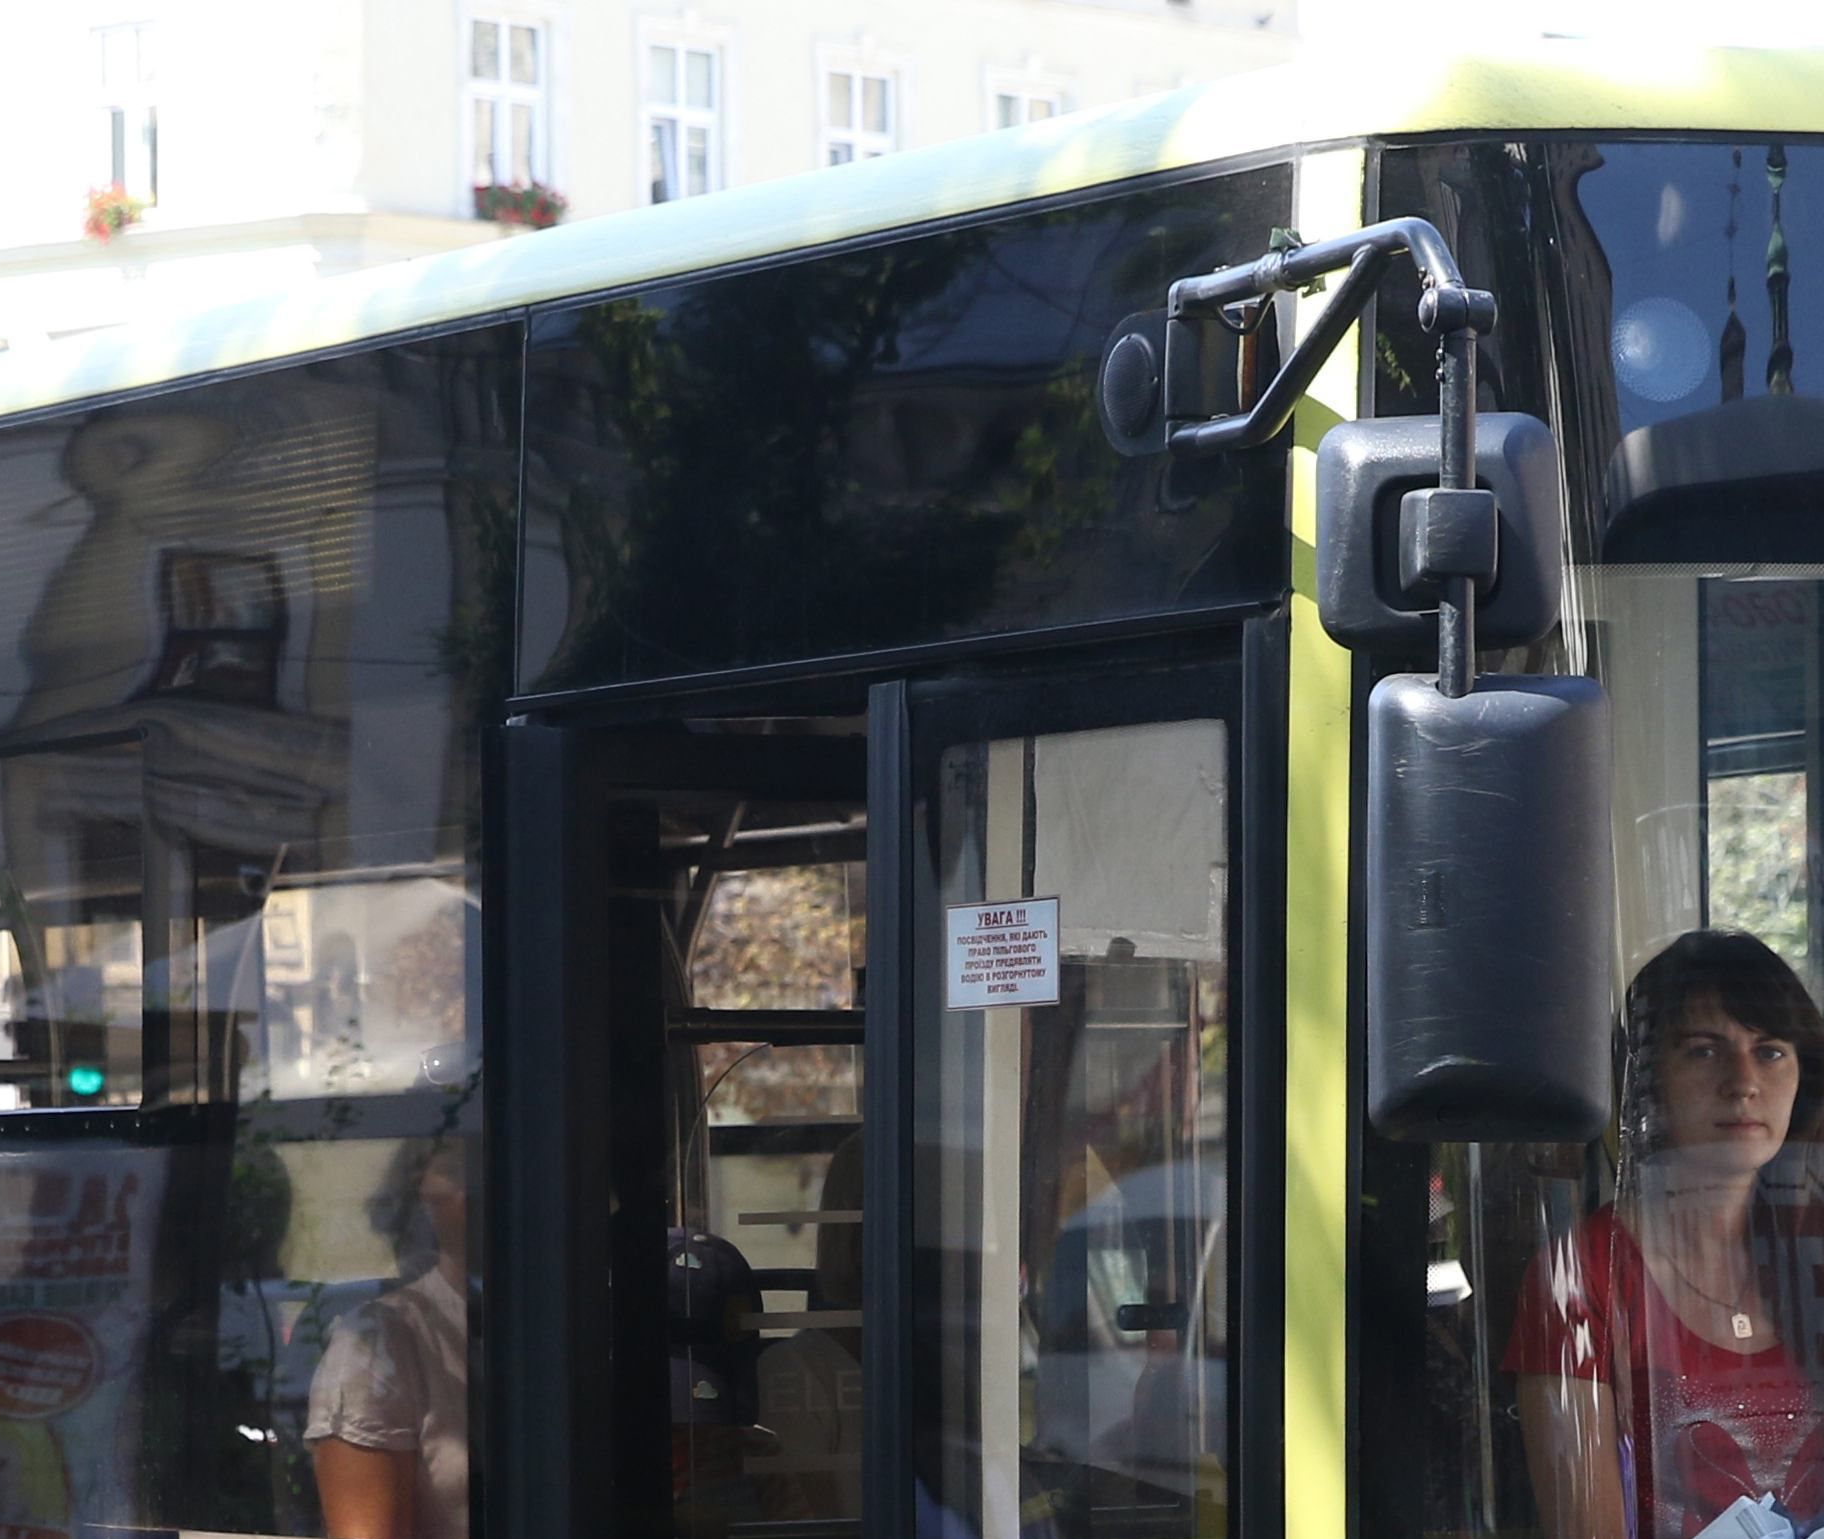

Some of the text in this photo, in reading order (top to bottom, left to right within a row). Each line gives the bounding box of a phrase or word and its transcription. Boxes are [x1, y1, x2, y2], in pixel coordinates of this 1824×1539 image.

[977, 909, 1026, 927] УВАГА !!!
[1022, 930, 1048, 943] ДАЮТЬ
[968, 947, 992, 957] ПРАВО
